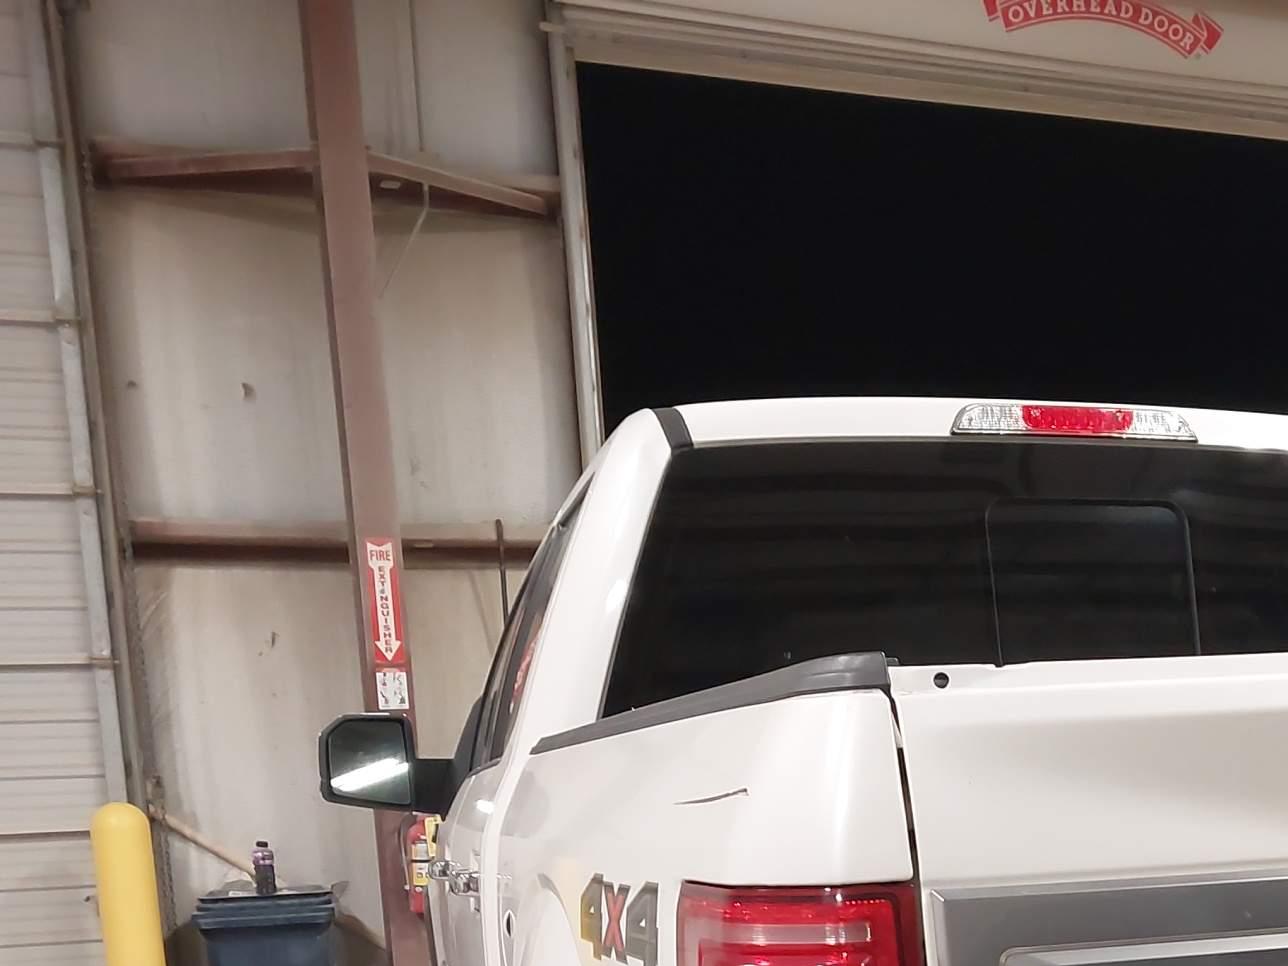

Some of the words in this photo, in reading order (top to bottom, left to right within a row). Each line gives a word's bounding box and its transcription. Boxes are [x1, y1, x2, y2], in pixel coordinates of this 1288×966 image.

[1008, 0, 1135, 23] OVERHEAD
[1139, 7, 1195, 50] DOOR
[369, 549, 392, 562] FIRE
[377, 565, 393, 654] EXTINGUISHER
